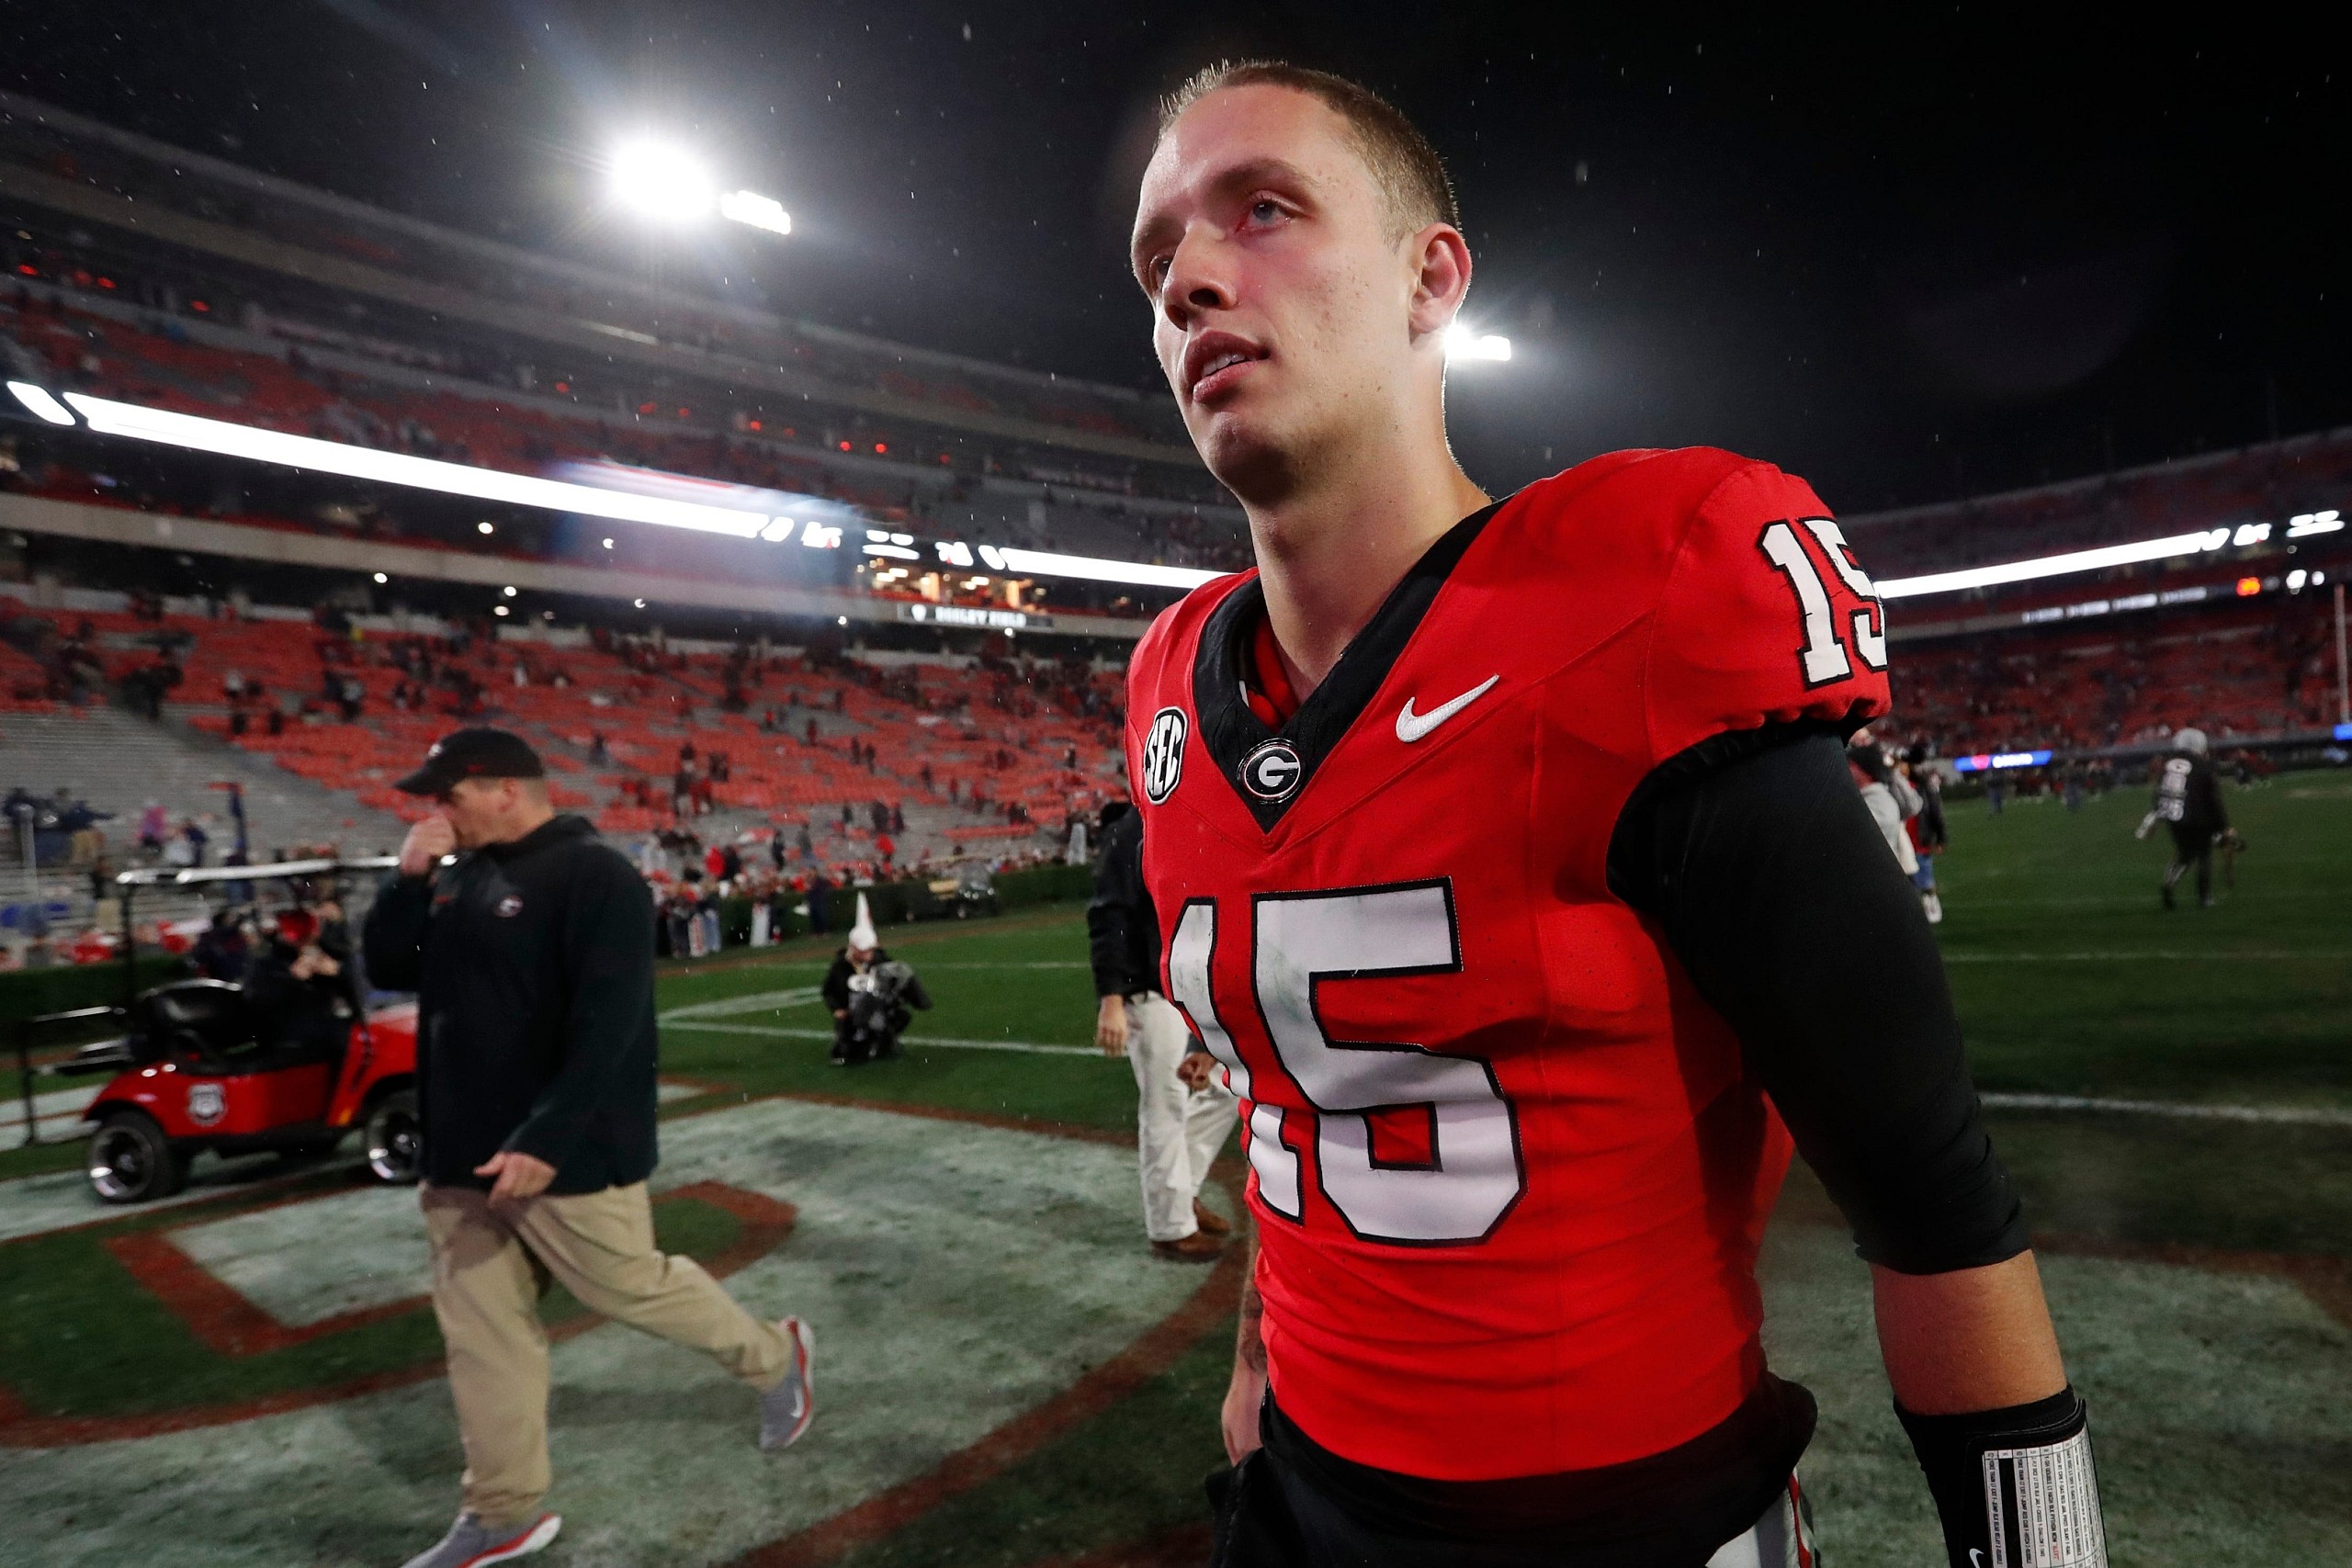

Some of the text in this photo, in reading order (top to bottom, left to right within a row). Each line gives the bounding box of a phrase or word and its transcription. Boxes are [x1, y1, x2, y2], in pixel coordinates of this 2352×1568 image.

[1757, 516, 1888, 690] 15
[1147, 715, 1184, 796] SEC
[1258, 756, 1301, 788] G
[1167, 875, 1530, 1247] 15
